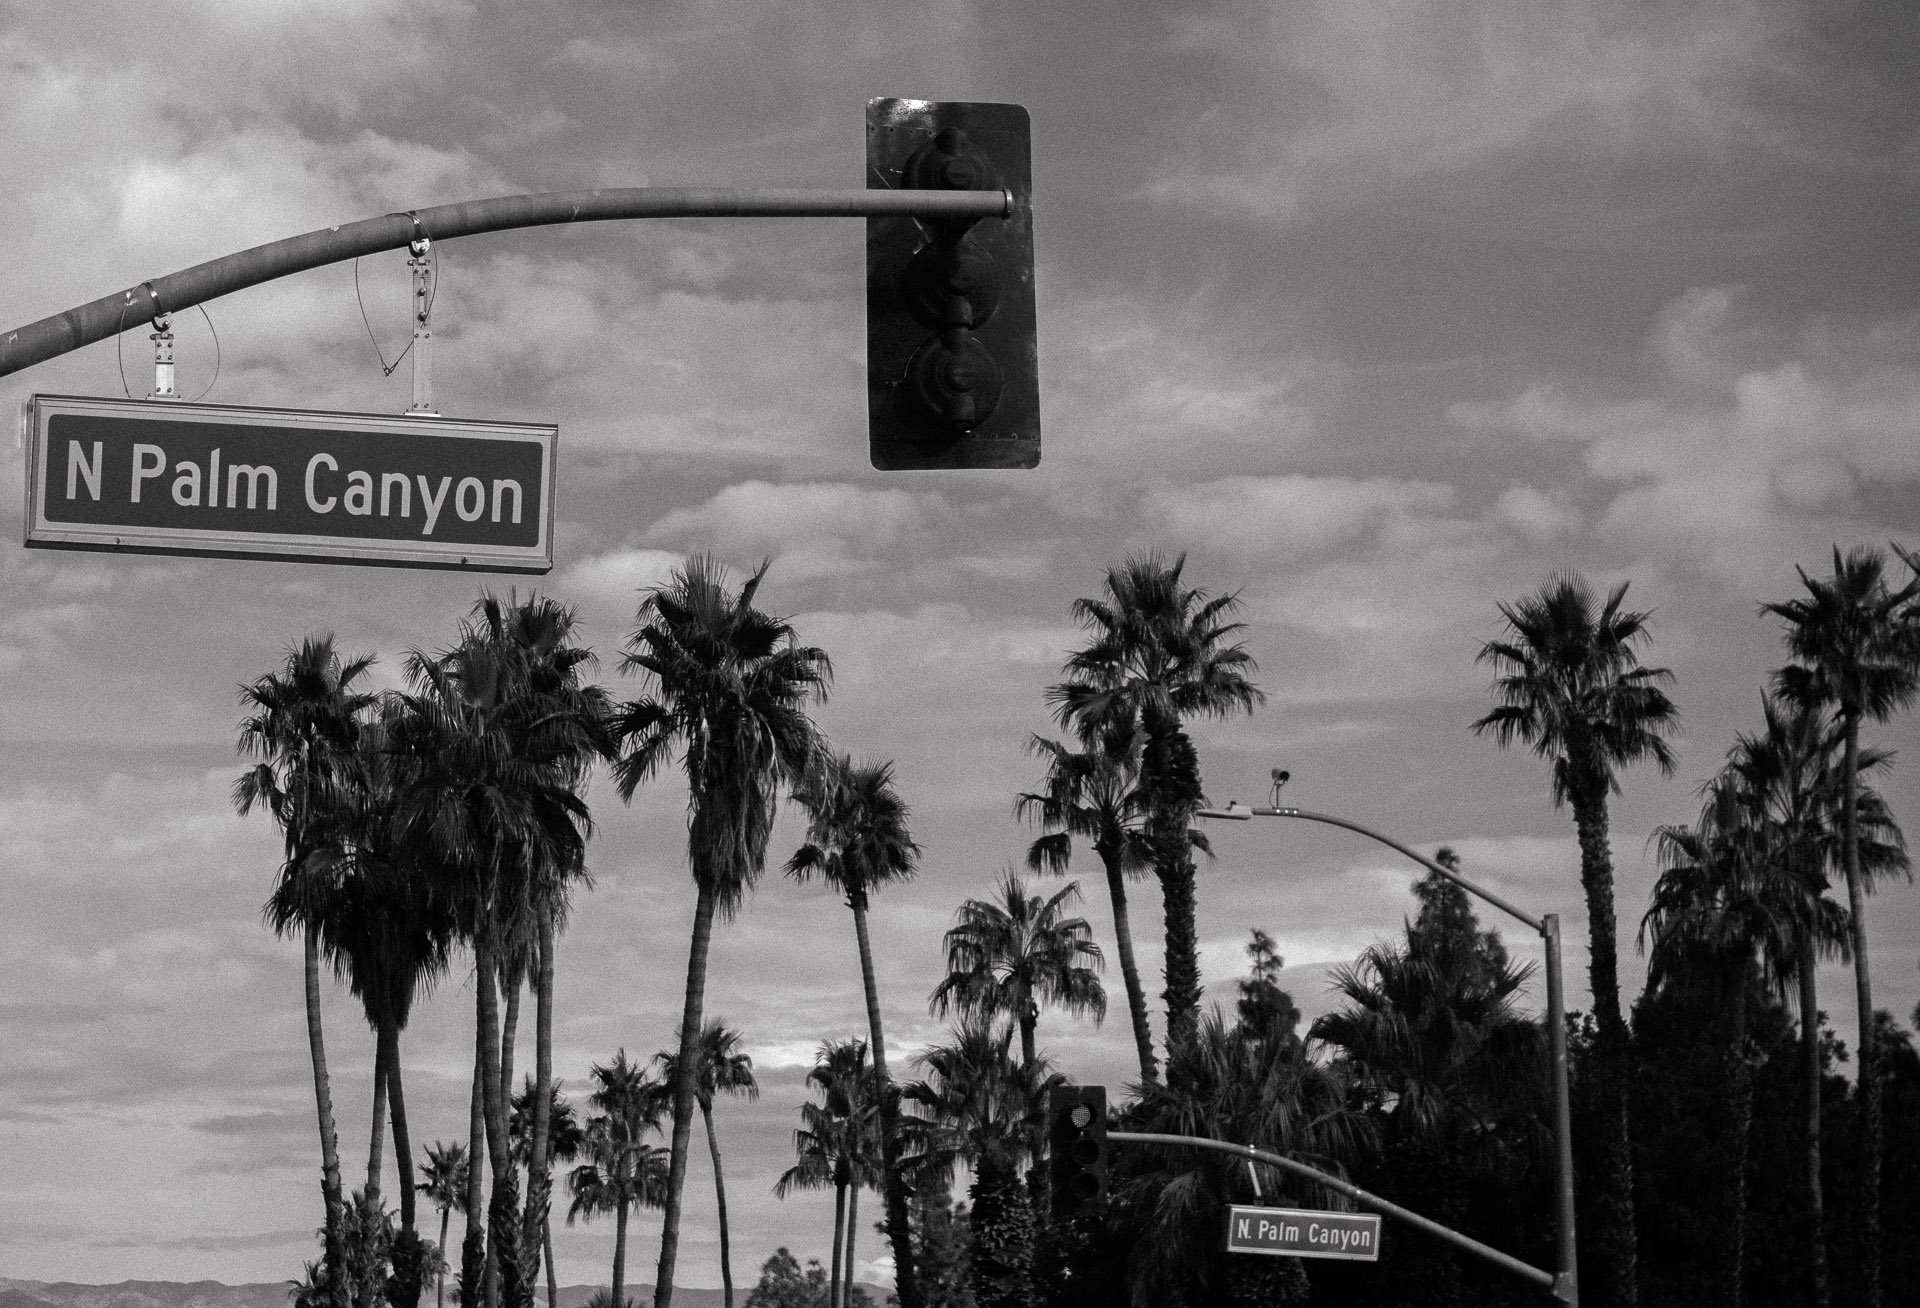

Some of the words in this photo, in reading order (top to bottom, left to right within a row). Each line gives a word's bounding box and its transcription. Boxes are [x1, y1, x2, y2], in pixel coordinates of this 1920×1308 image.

[67, 440, 103, 500] N
[131, 444, 277, 510] Palm
[305, 452, 523, 534] Canyon
[1237, 1218, 1251, 1239] N.
[1258, 1219, 1300, 1242] Palm
[1308, 1222, 1371, 1251] Canyon
